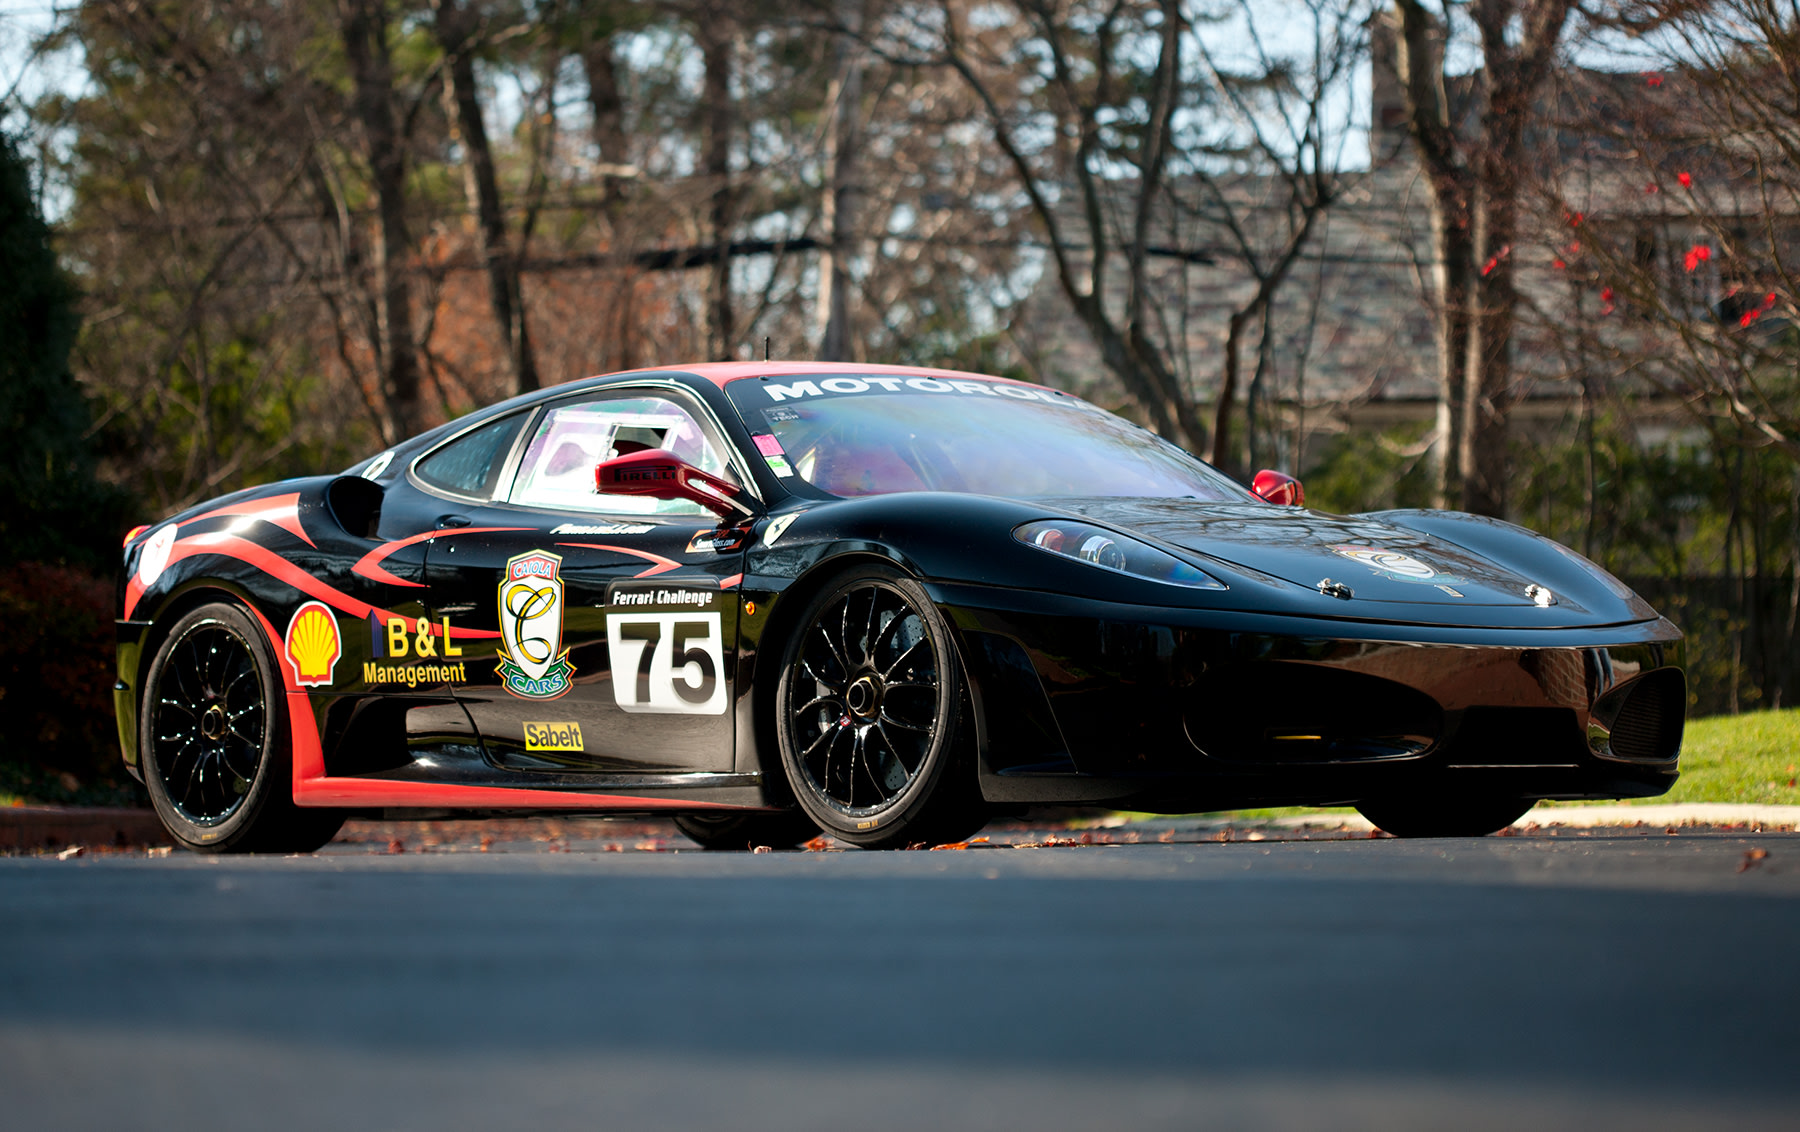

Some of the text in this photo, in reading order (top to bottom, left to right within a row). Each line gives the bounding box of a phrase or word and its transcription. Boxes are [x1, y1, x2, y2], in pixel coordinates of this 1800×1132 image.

[614, 465, 676, 482] PIRELLI
[514, 561, 551, 579] CAIOLA
[613, 589, 713, 608] Ferrari Challenge
[387, 616, 462, 658] B & L
[619, 621, 717, 704] 75
[363, 662, 467, 688] Management
[511, 673, 563, 694] CARS
[526, 723, 581, 748] Sabelt
